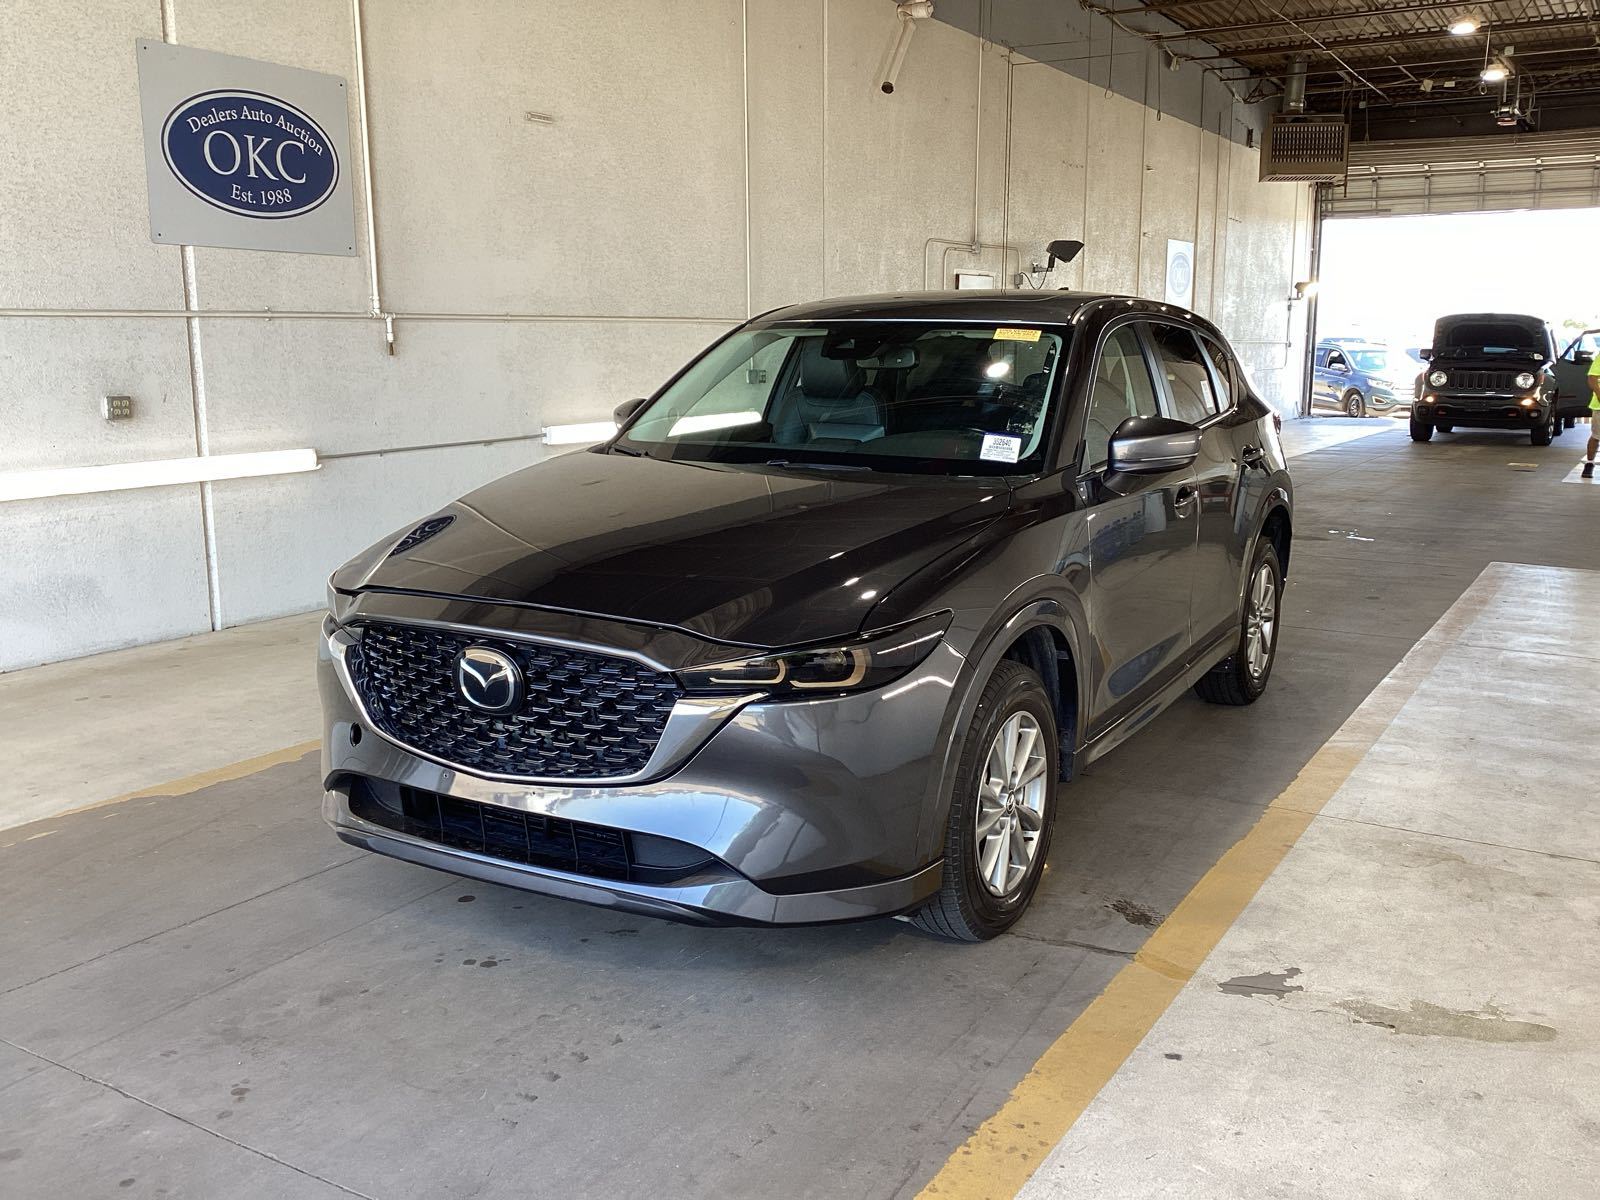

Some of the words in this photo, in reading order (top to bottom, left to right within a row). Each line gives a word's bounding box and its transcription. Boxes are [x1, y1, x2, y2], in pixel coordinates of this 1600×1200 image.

[186, 108, 238, 133] Dealers
[240, 105, 273, 124] Auto
[275, 115, 323, 156] Auction
[203, 130, 307, 184] OKC
[230, 183, 257, 204] Est.
[260, 188, 292, 205] 1988
